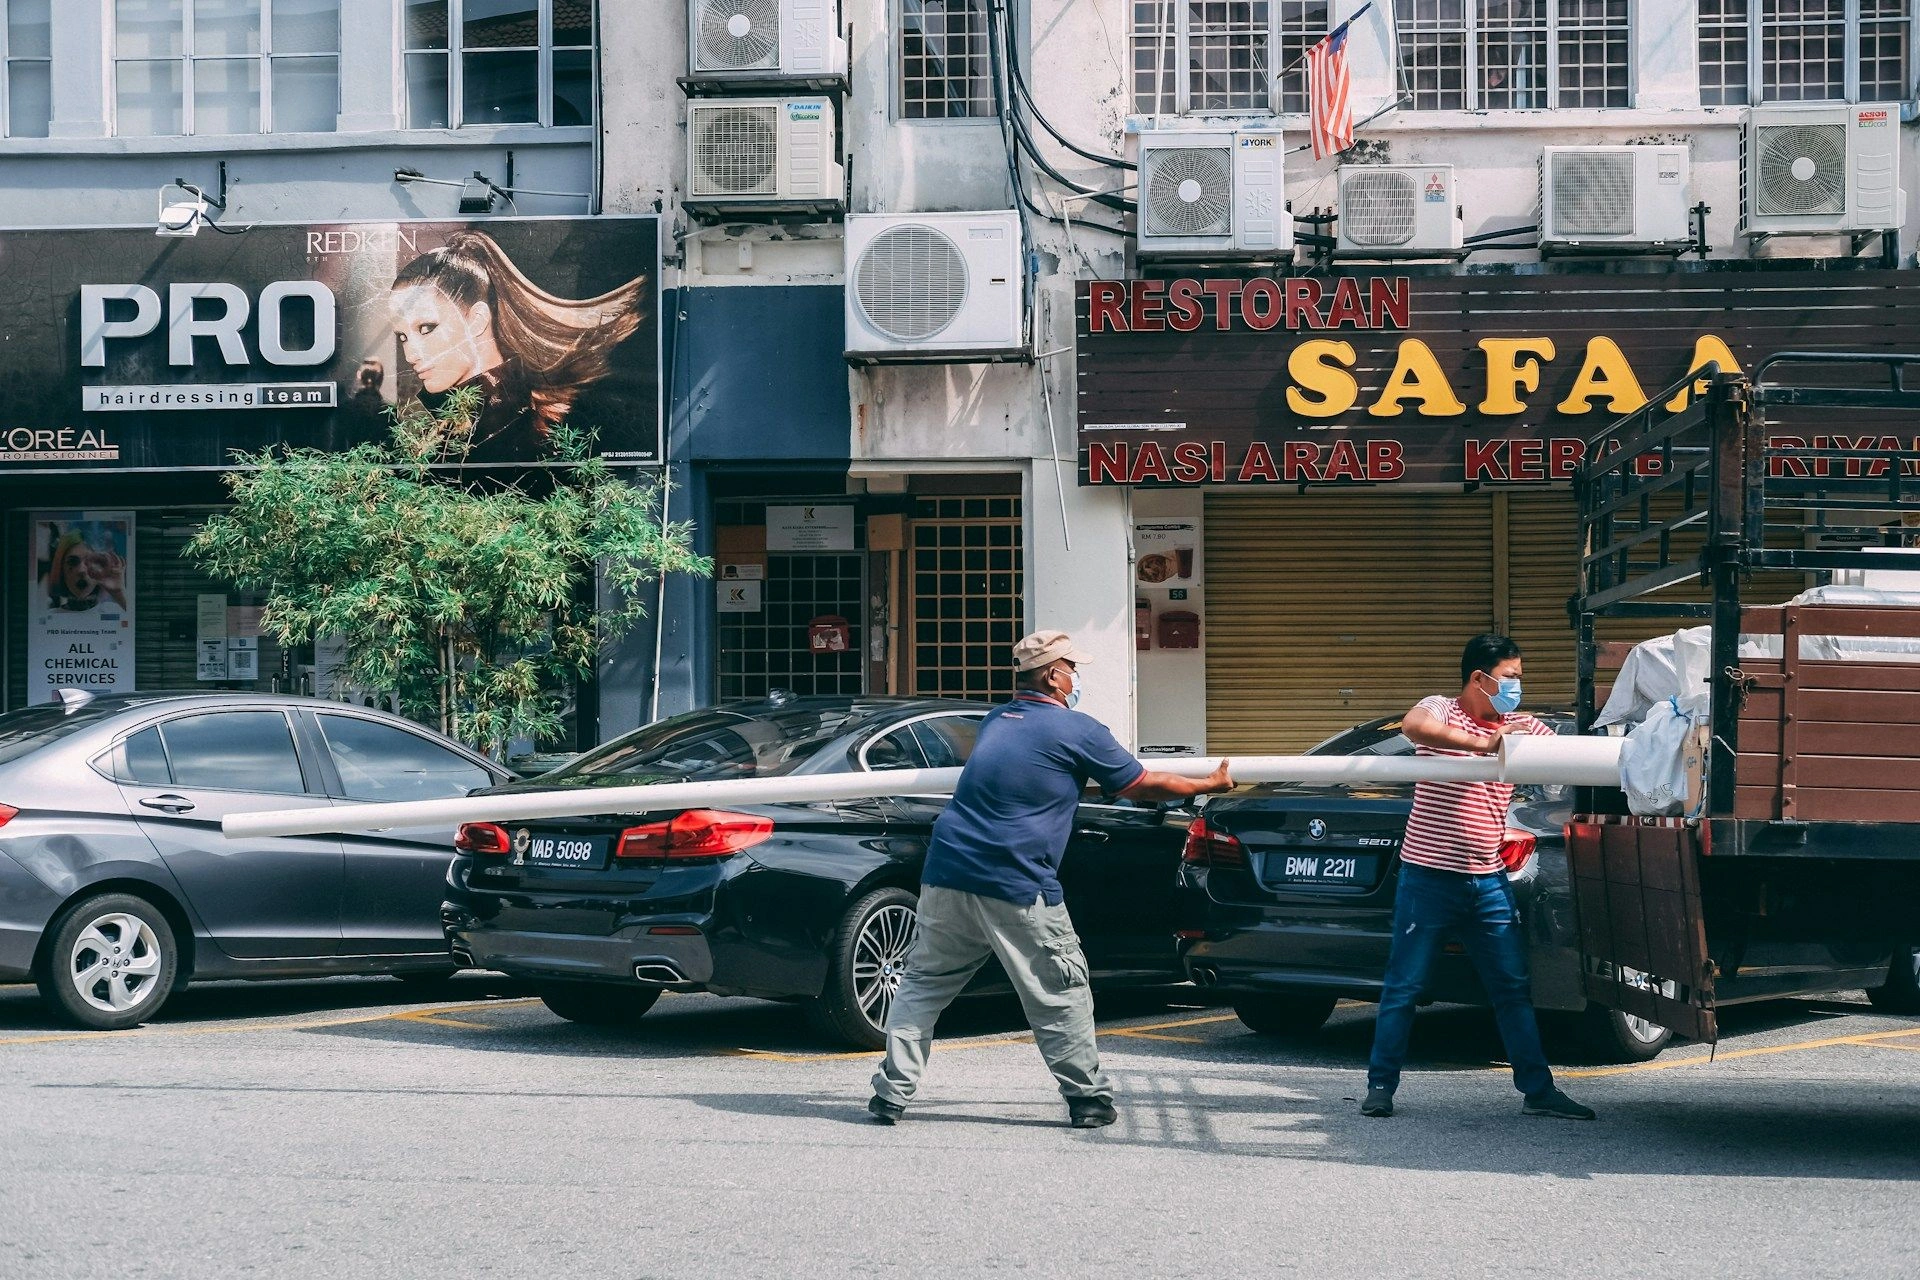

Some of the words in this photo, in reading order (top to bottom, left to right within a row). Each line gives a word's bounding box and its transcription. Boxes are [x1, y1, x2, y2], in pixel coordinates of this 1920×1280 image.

[1249, 138, 1273, 147] YORK
[306, 230, 417, 254] REDKEN
[1089, 276, 1411, 332] RESTORAN
[80, 280, 336, 367] PRO
[100, 390, 254, 406] hairdressing
[267, 389, 323, 402] team
[0, 427, 120, 451] 'ORÉAL
[1088, 440, 1226, 483] NASI
[1237, 439, 1406, 482] ARAB
[1769, 435, 1920, 477] RIYA
[1172, 590, 1184, 599] 56
[67, 643, 95, 654] ALL
[44, 658, 119, 669] CHEMICAL
[47, 673, 116, 684] SERVICES
[531, 838, 555, 859] VAB
[555, 840, 592, 861] 5098
[1285, 856, 1319, 877] BMW
[1322, 858, 1356, 878] 2211
